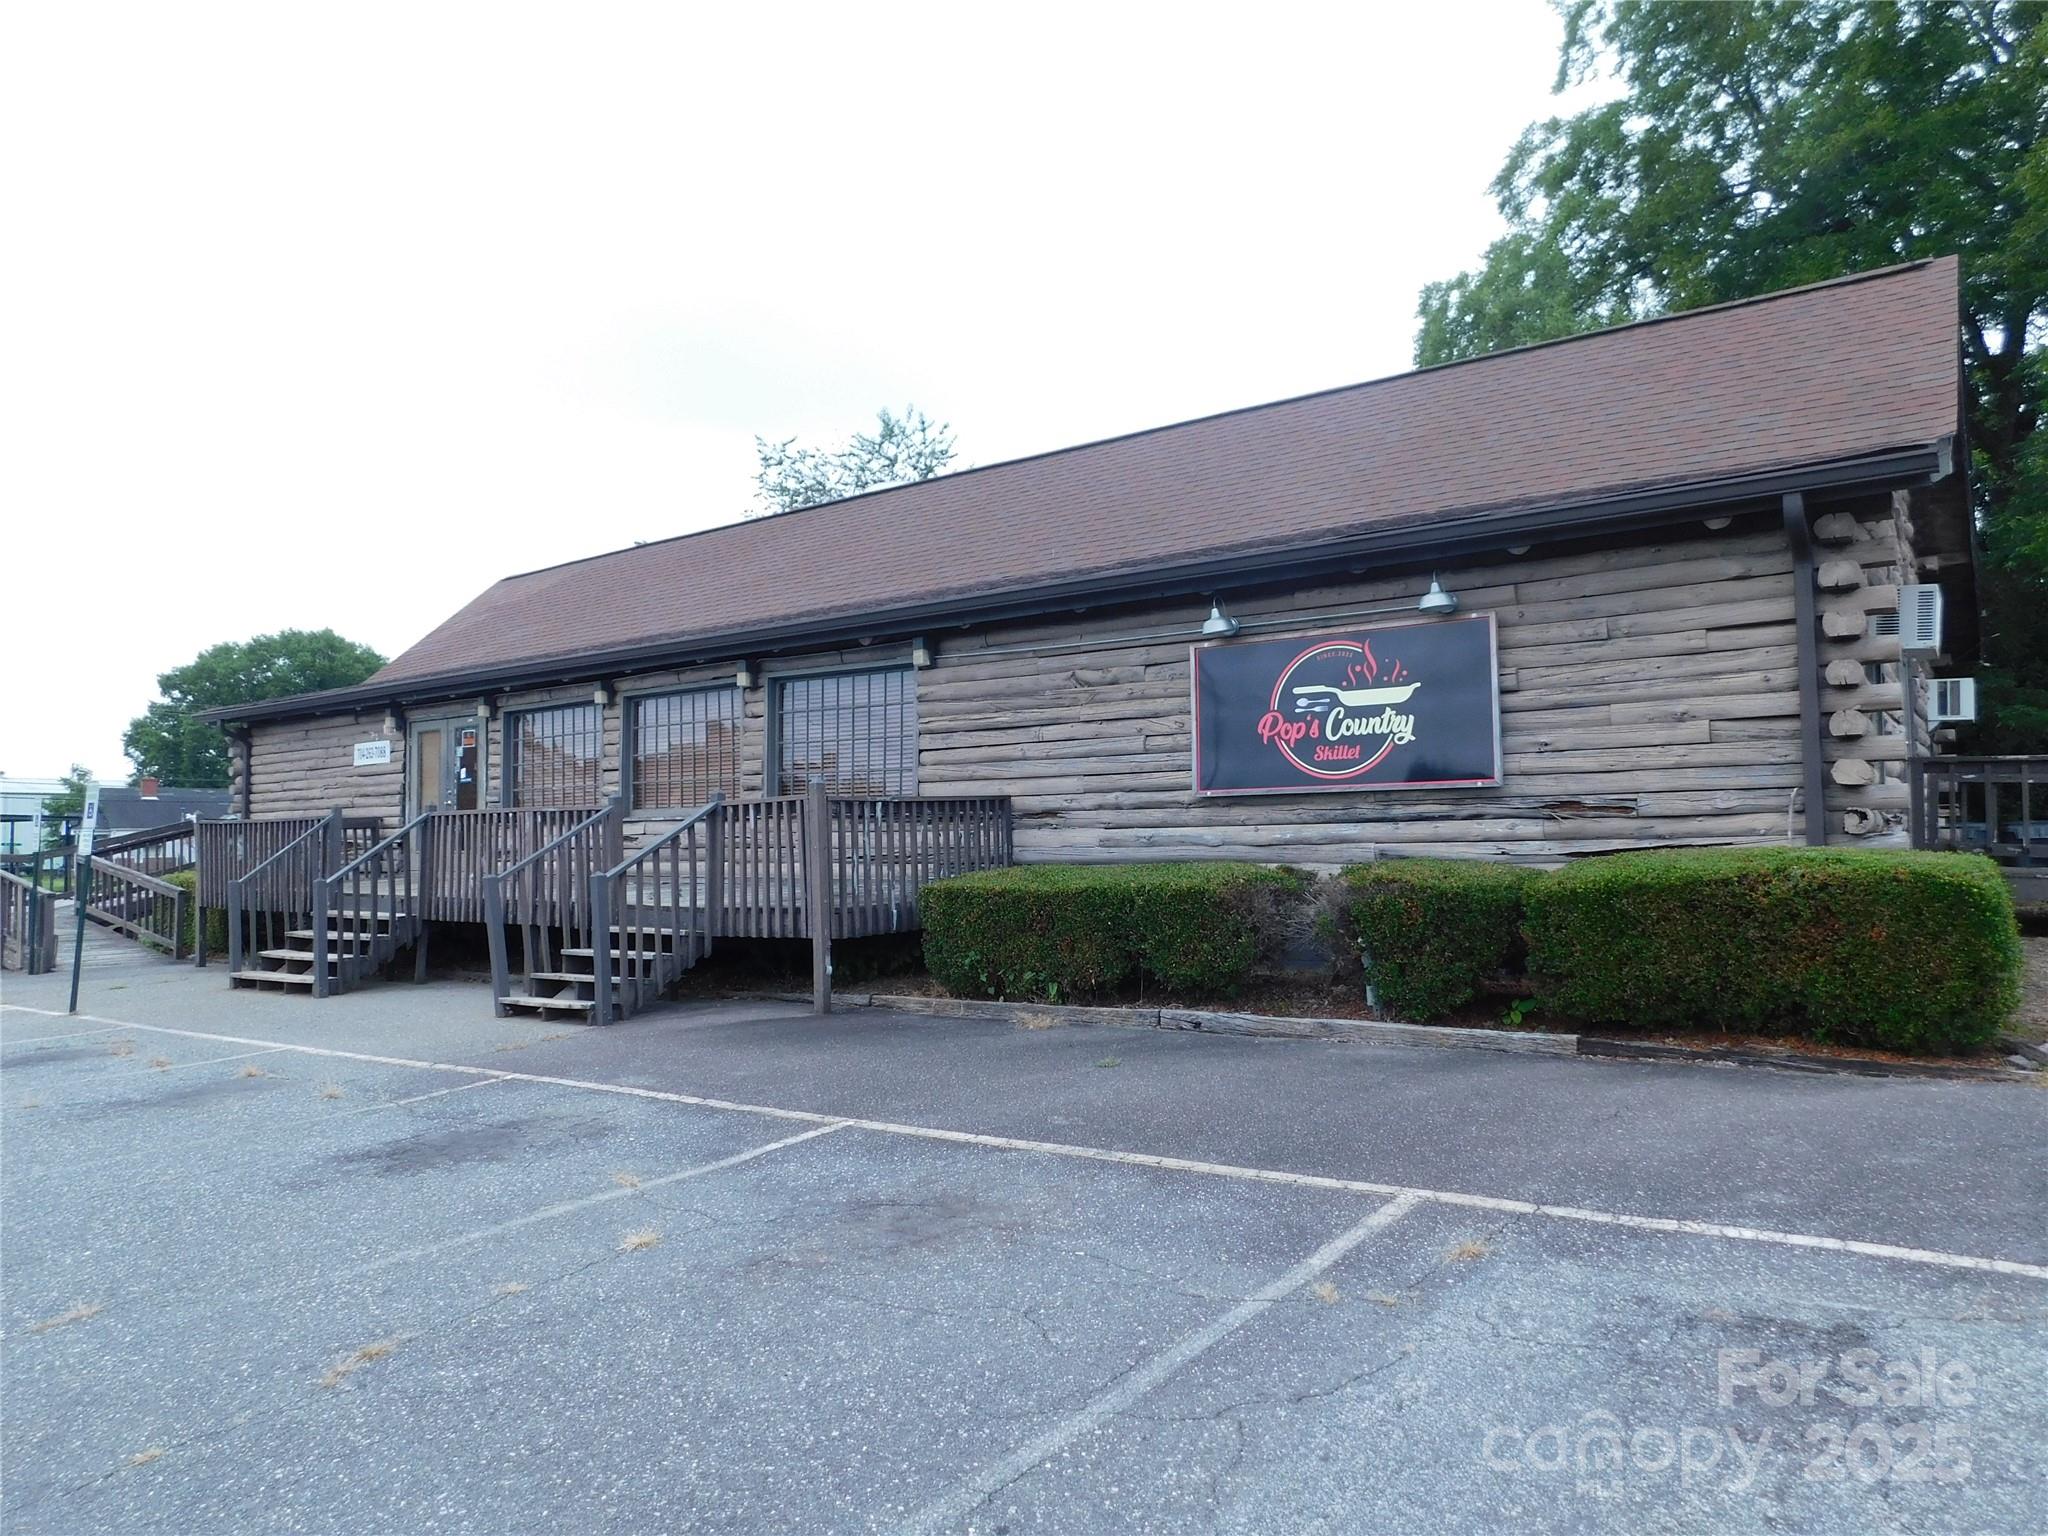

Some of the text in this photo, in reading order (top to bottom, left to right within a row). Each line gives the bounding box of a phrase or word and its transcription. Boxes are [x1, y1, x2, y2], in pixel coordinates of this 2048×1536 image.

[1258, 707, 1416, 748] Pop's Country
[1314, 745, 1360, 761] Skillet
